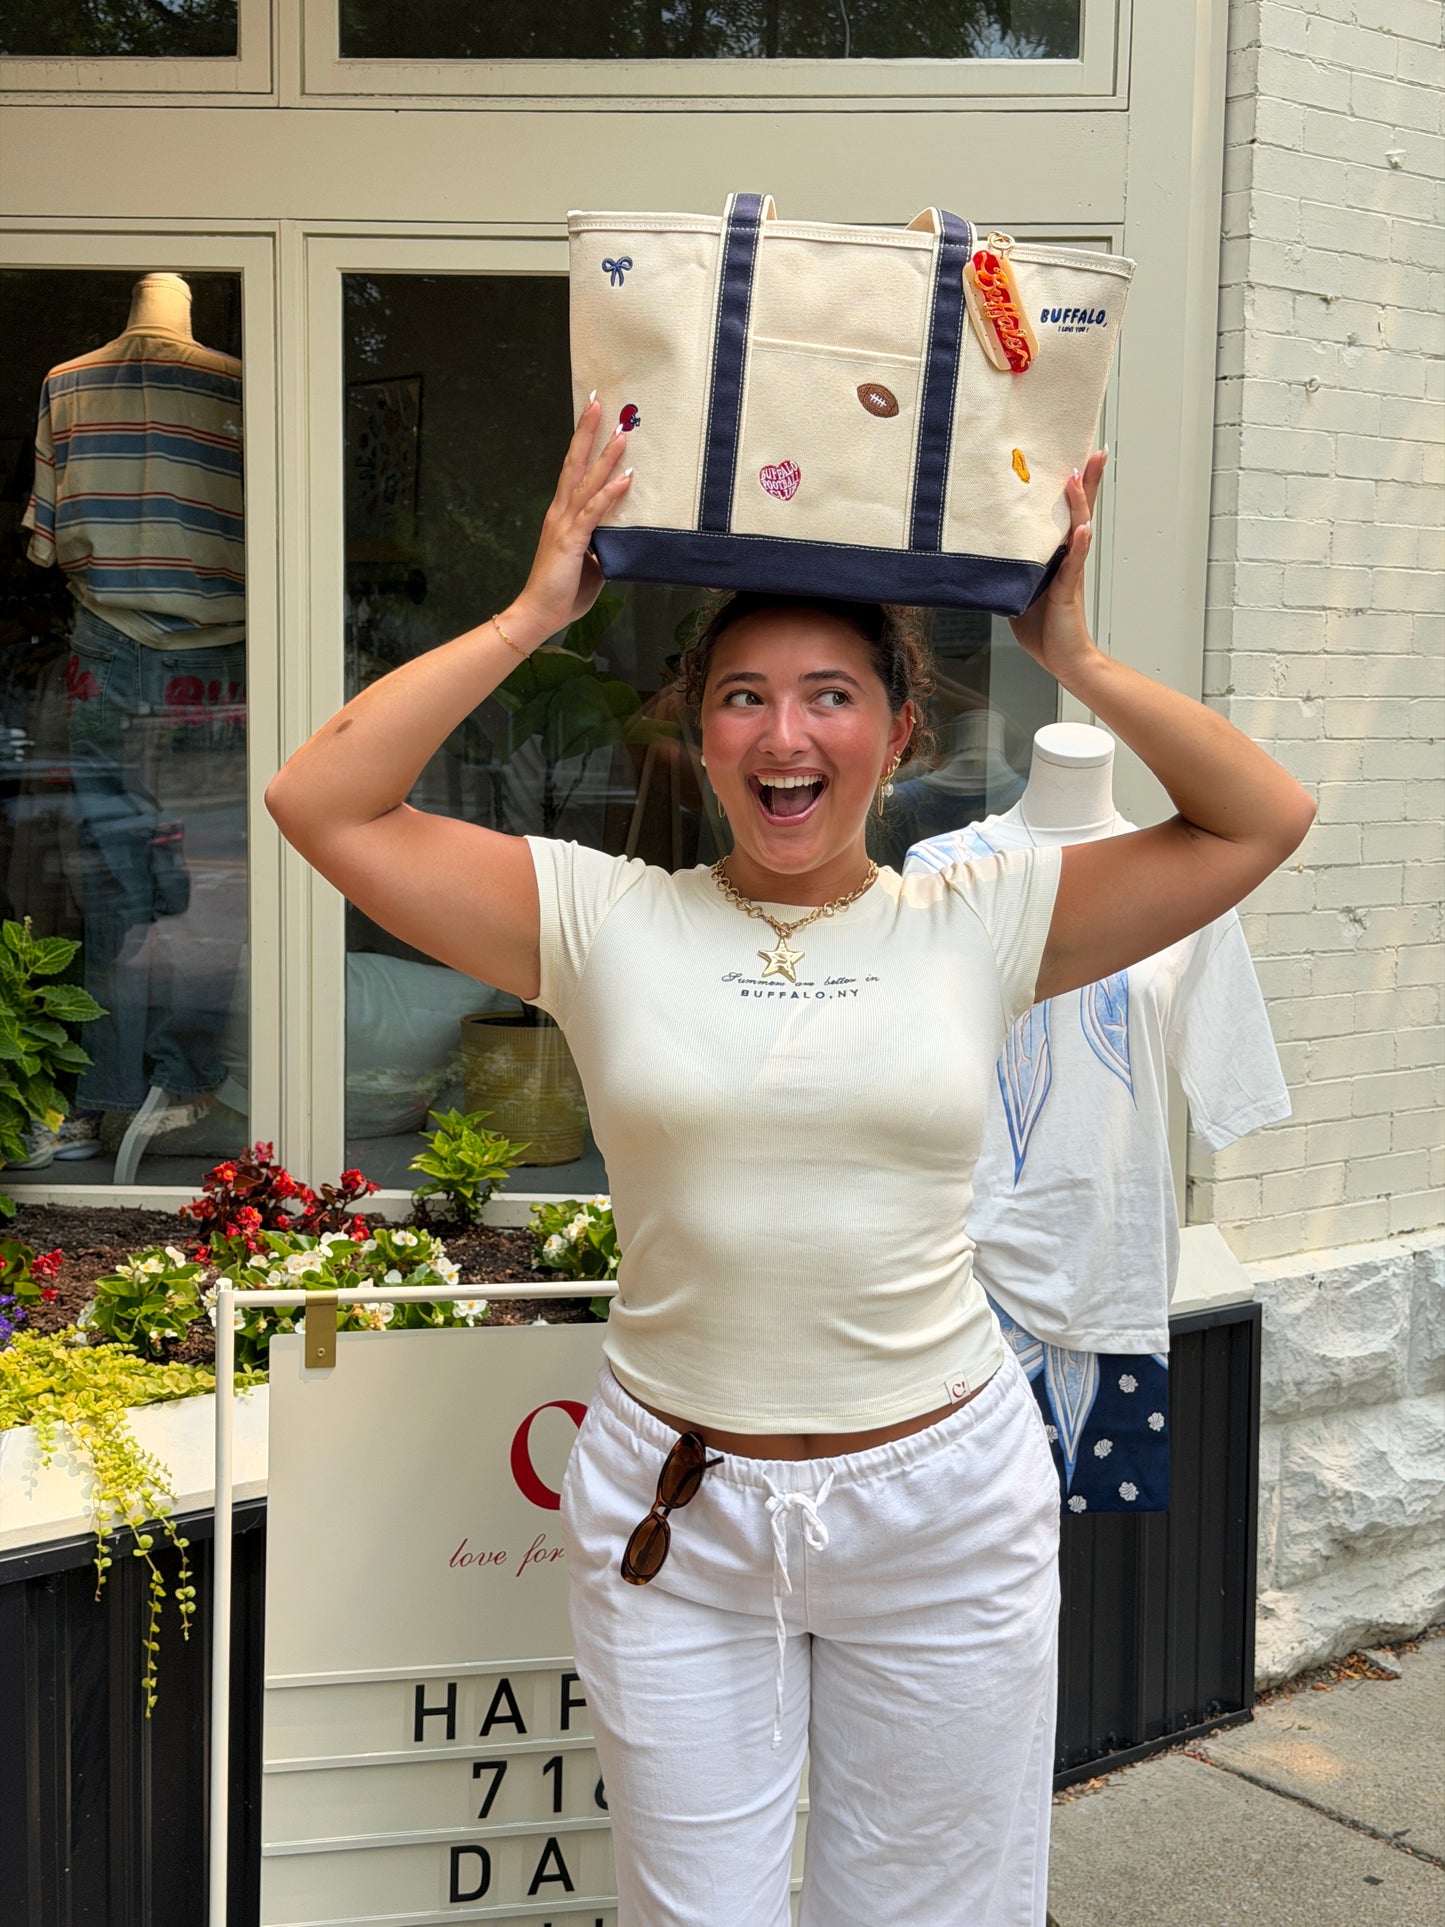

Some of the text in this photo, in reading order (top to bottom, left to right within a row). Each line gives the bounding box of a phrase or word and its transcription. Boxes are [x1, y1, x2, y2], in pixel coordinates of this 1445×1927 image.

[761, 461, 797, 480] BUFFALO
[762, 472, 800, 490] FOOTBALL
[824, 976, 857, 987] better
[865, 974, 880, 983] in
[449, 1533, 565, 1577] love for
